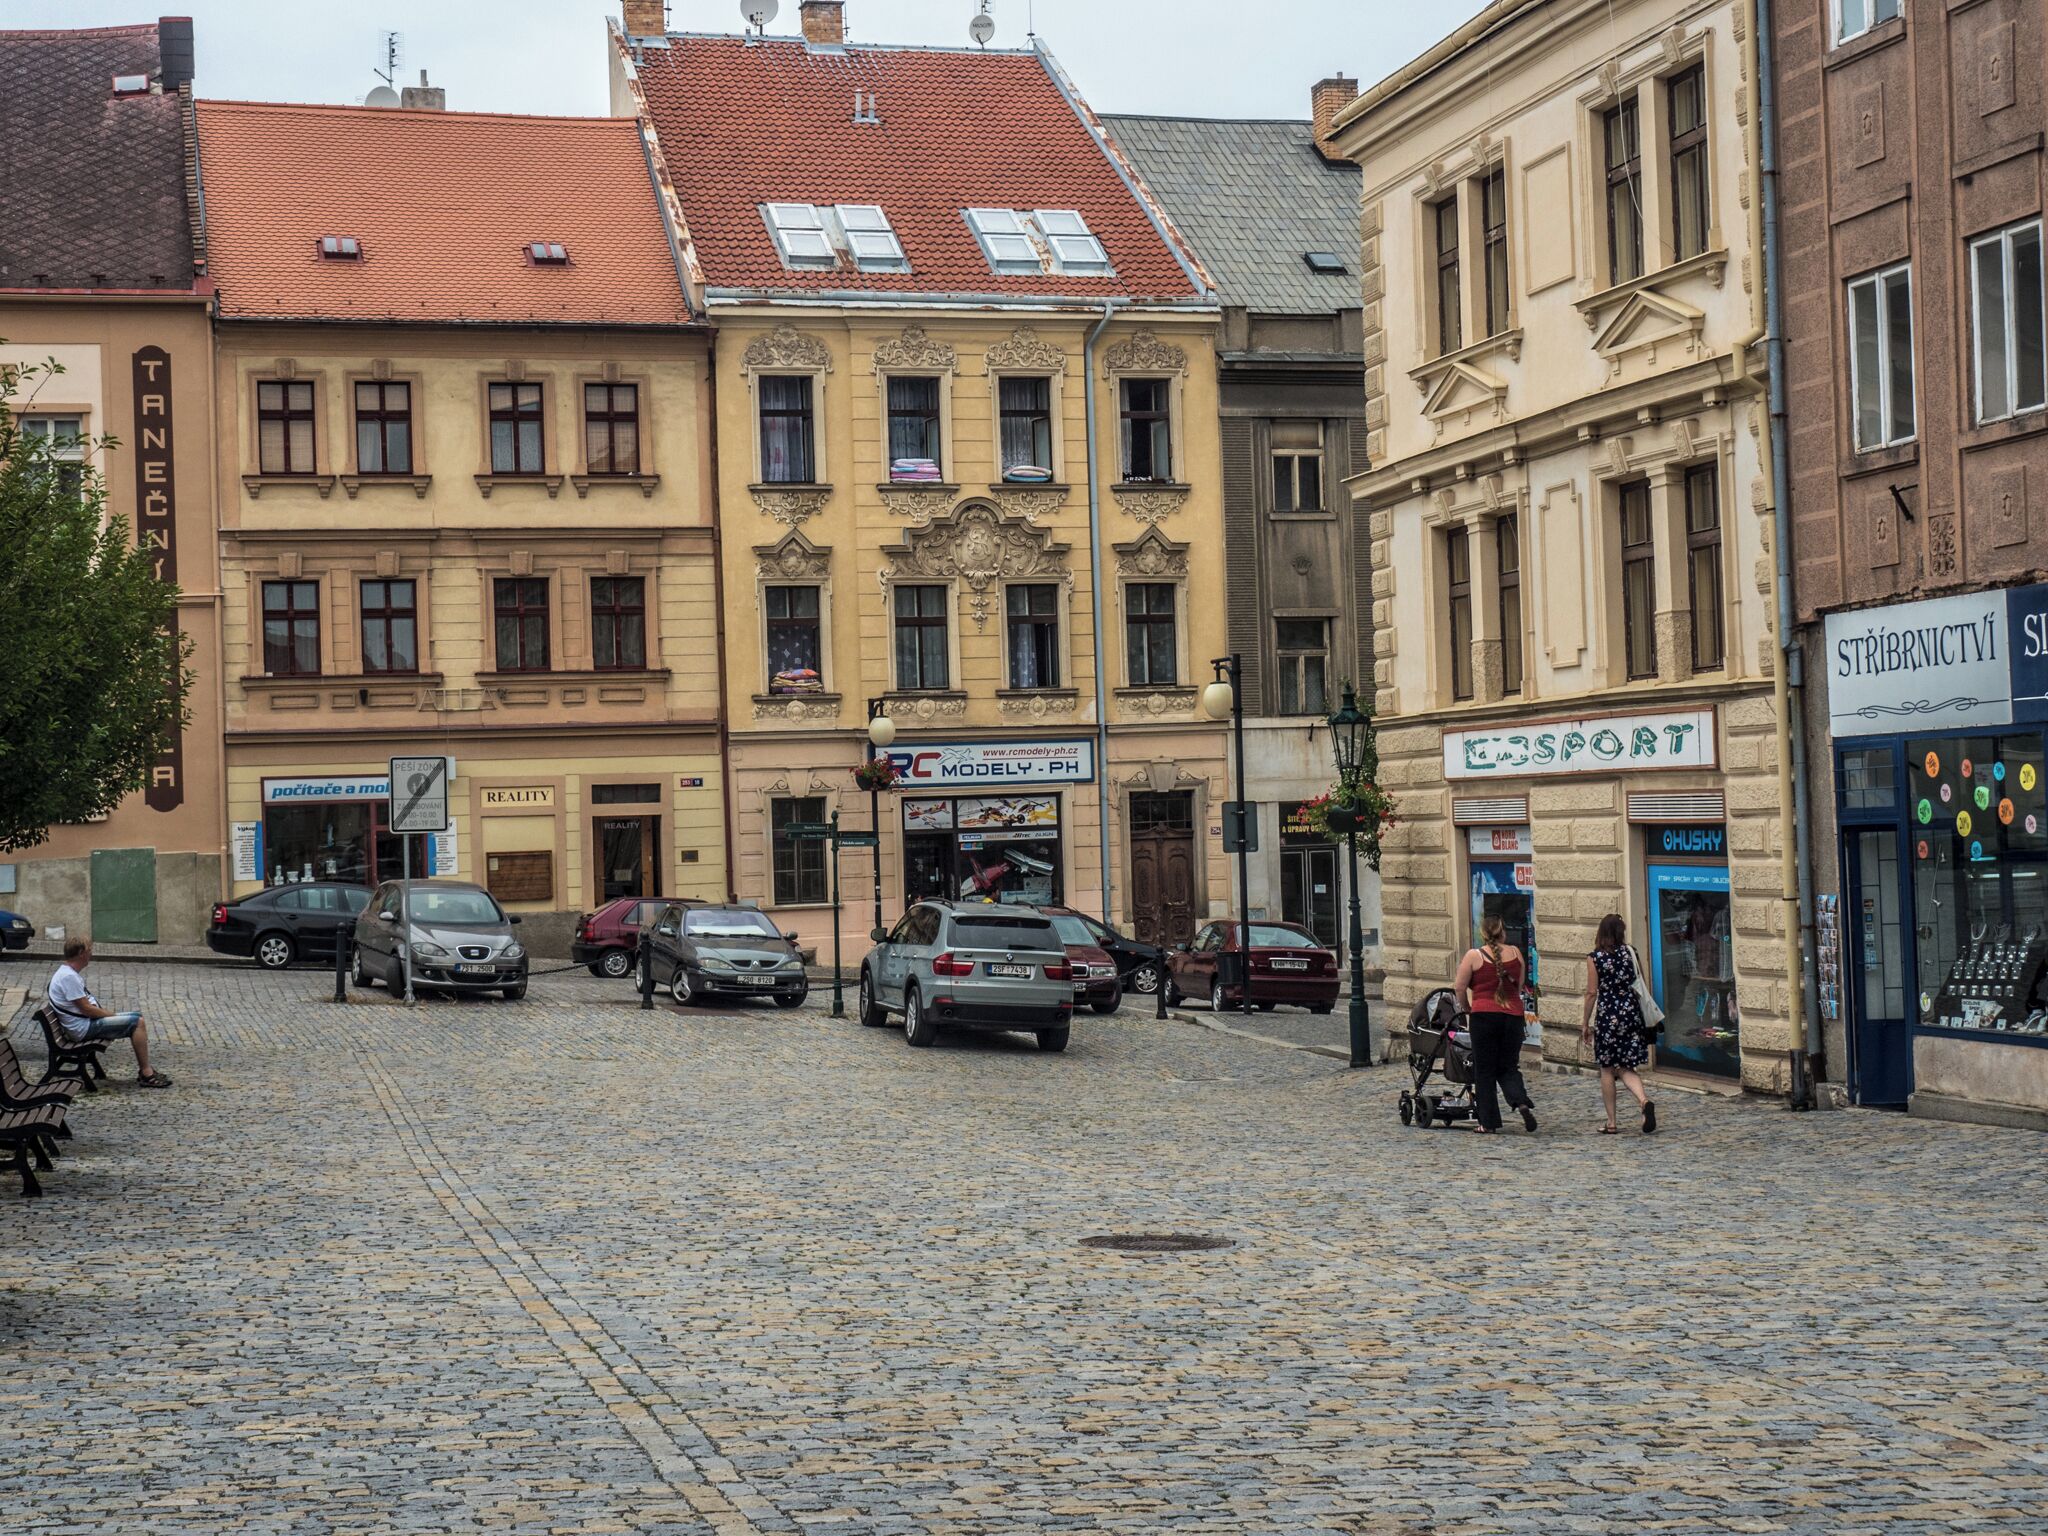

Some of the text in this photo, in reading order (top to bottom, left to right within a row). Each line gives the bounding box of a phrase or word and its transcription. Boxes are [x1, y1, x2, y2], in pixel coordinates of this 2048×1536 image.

[1838, 612, 1996, 677] STŘÍBRNICTVÍ
[983, 746, 1079, 757] www.rcmodely-ph.cz
[942, 762, 1031, 777] MODELY
[1049, 761, 1079, 774] PH
[272, 783, 342, 799] počítače
[345, 785, 355, 793] a
[487, 790, 550, 803] REALITY
[604, 821, 640, 830] REALITY
[1010, 966, 1028, 974] 7438
